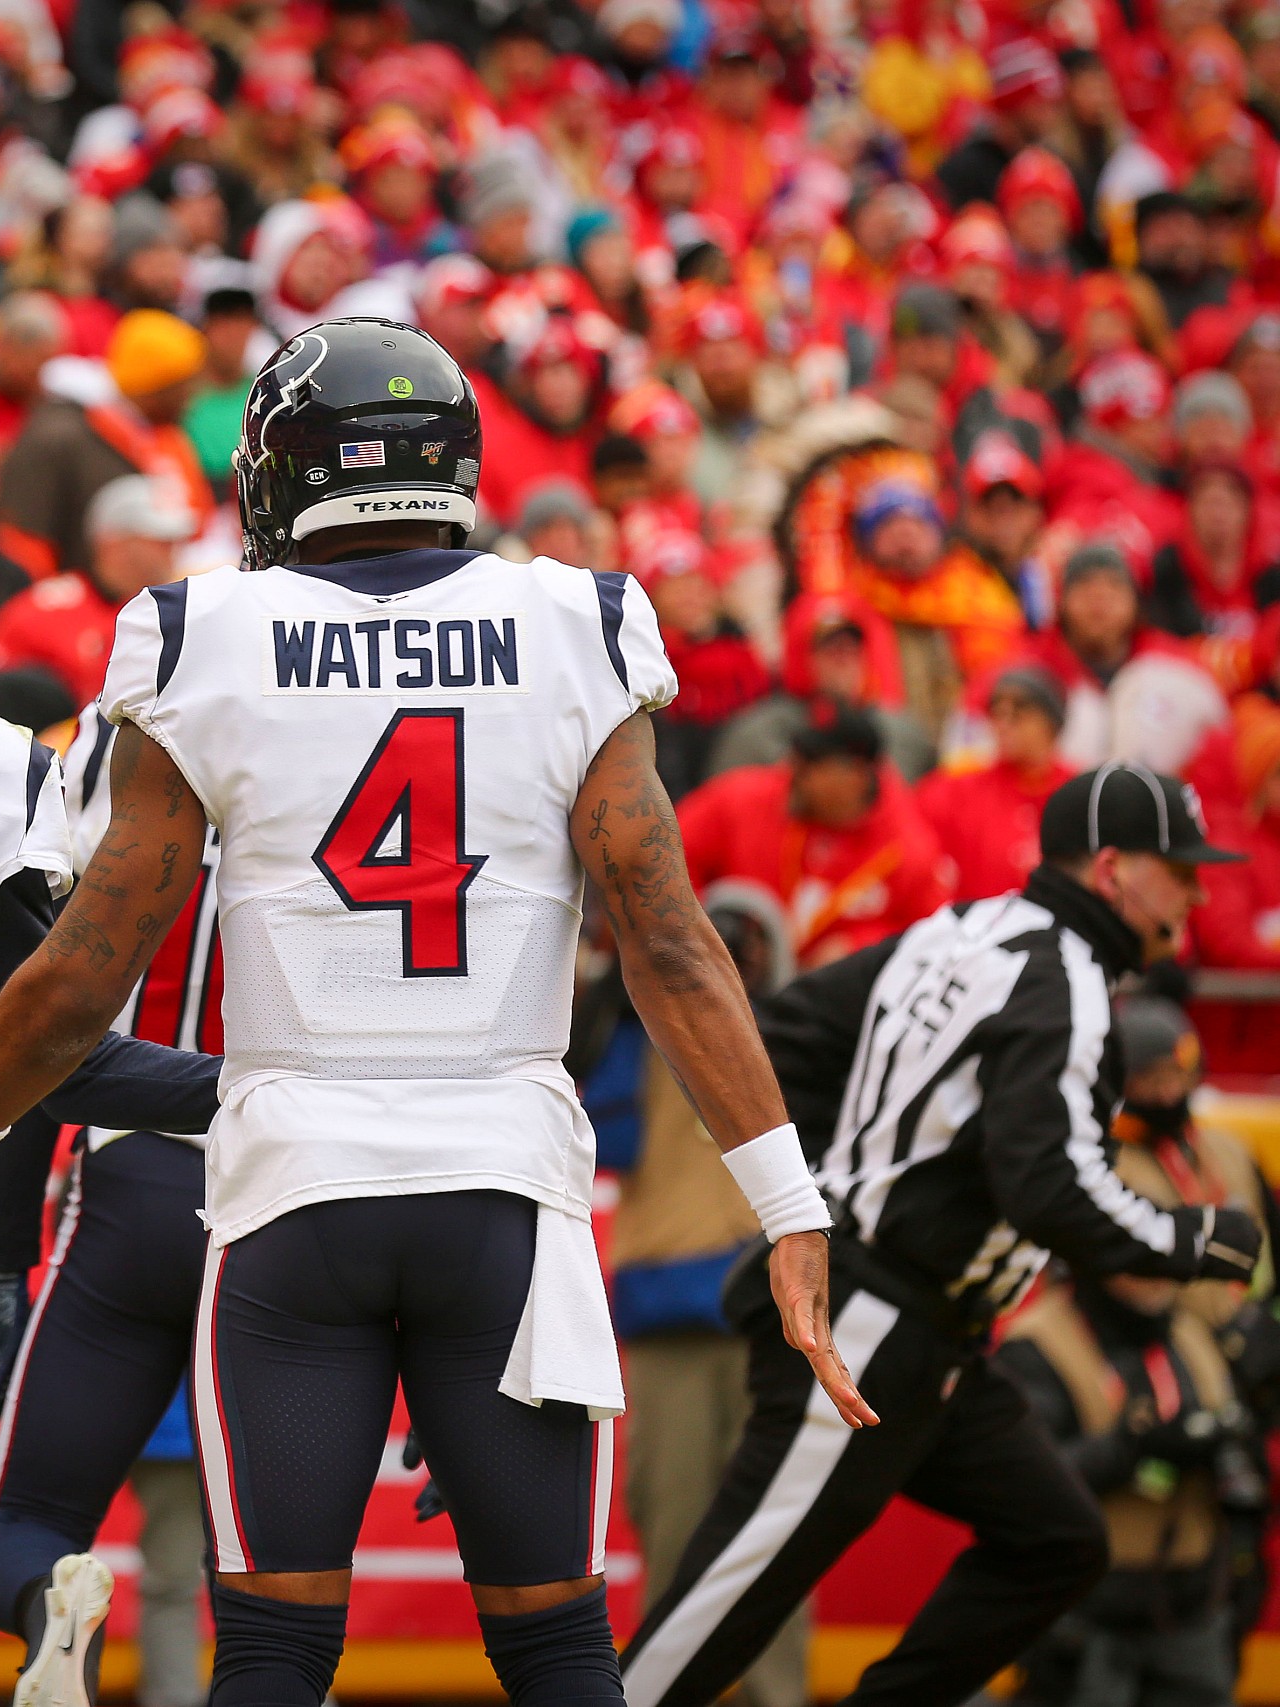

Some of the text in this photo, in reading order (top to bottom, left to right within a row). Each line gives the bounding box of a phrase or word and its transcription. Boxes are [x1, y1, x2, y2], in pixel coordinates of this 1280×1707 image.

[353, 501, 450, 513] TEXANS
[272, 618, 519, 689] WATSON
[311, 707, 490, 978] 4
